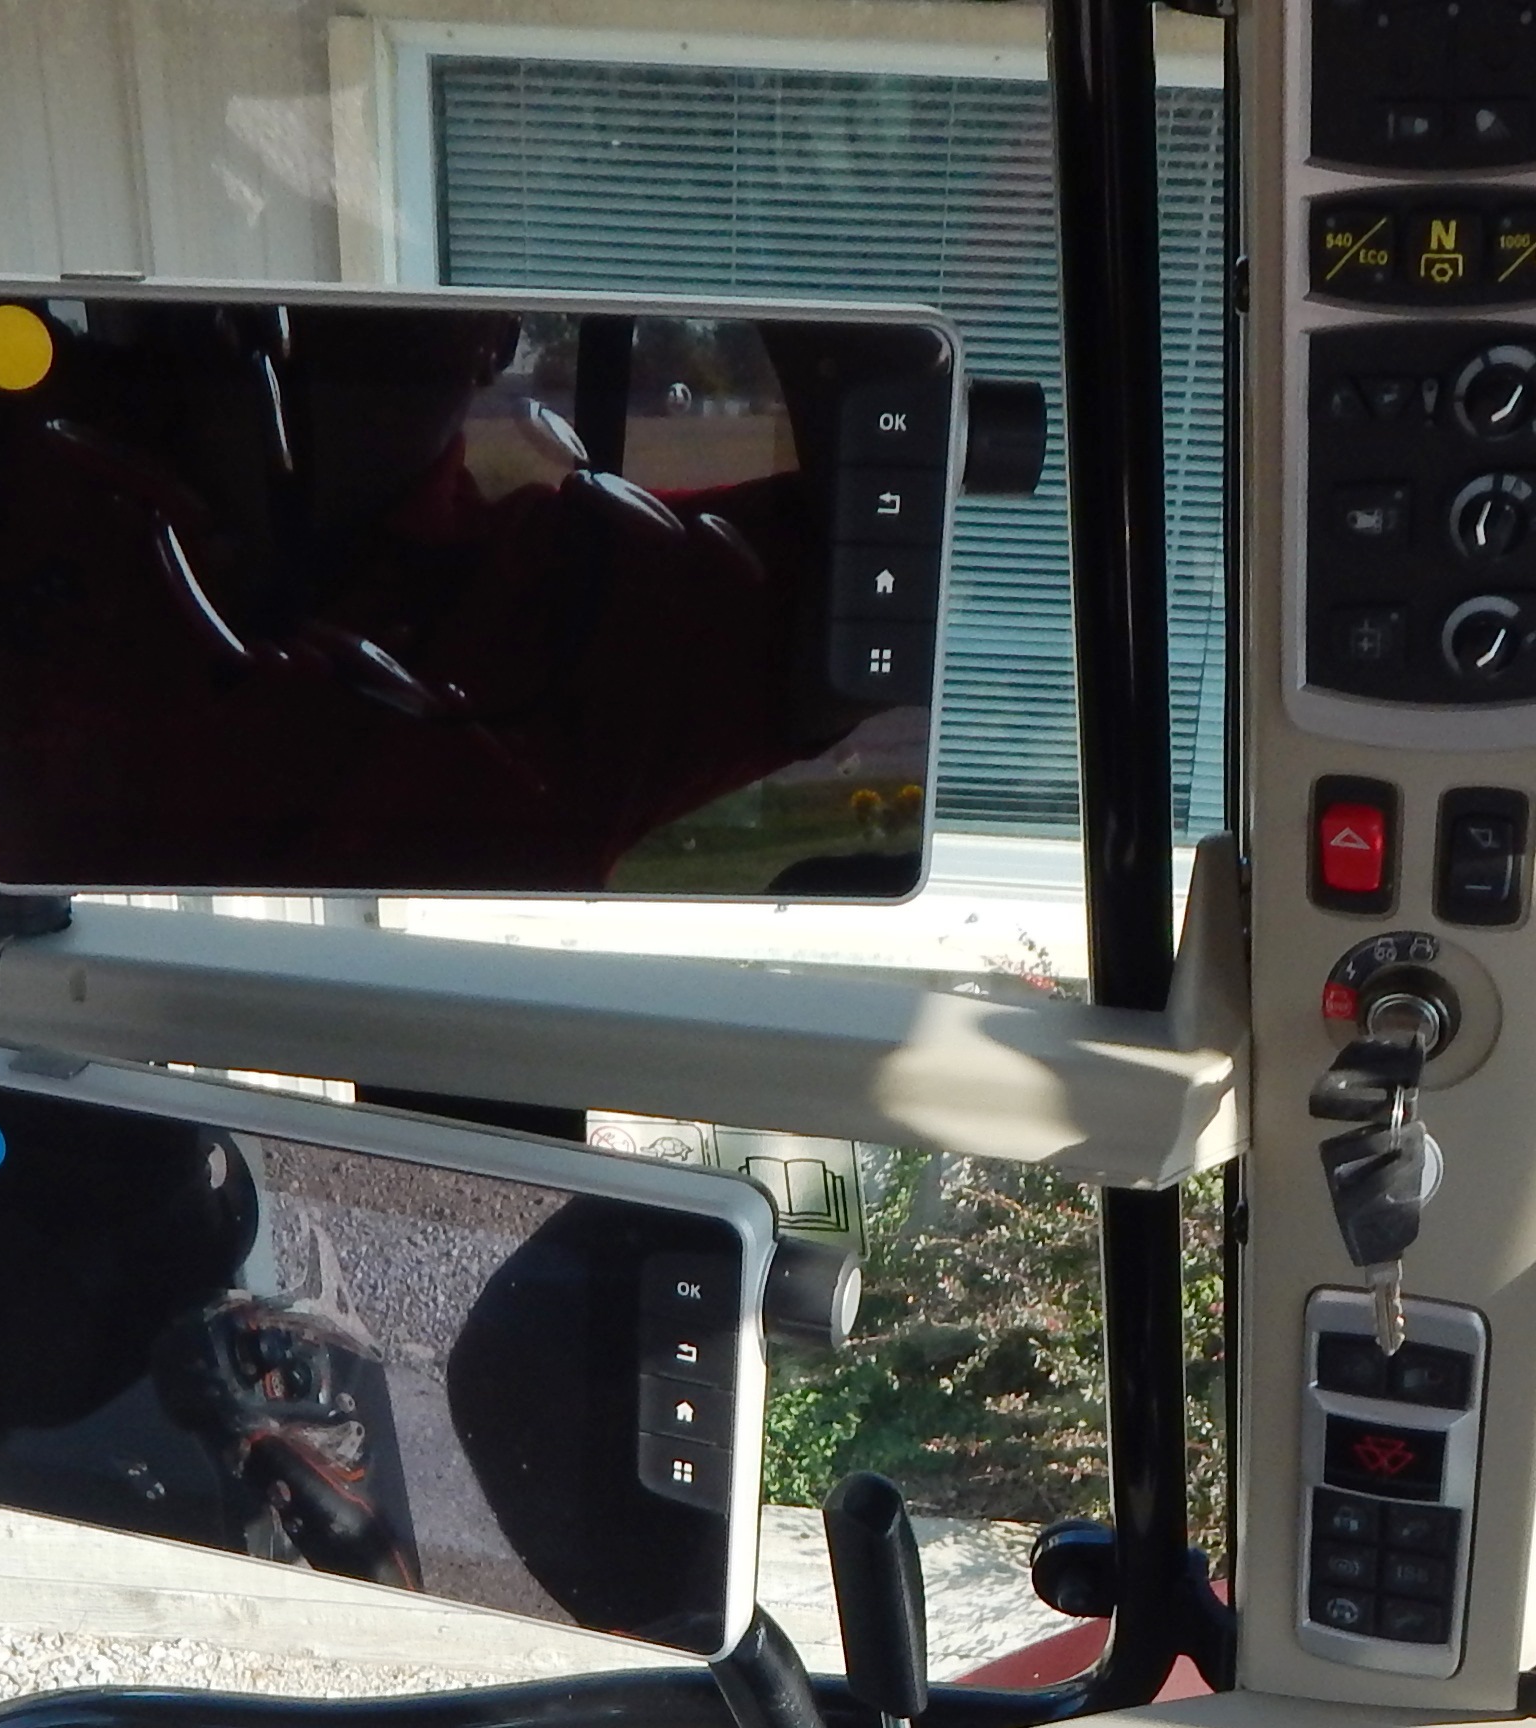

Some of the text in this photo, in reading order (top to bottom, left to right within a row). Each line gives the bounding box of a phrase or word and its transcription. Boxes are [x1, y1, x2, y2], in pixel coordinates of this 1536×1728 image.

[1430, 219, 1457, 250] N
[1359, 250, 1388, 265] ECO
[879, 412, 907, 431] OK
[676, 1281, 701, 1299] OK
